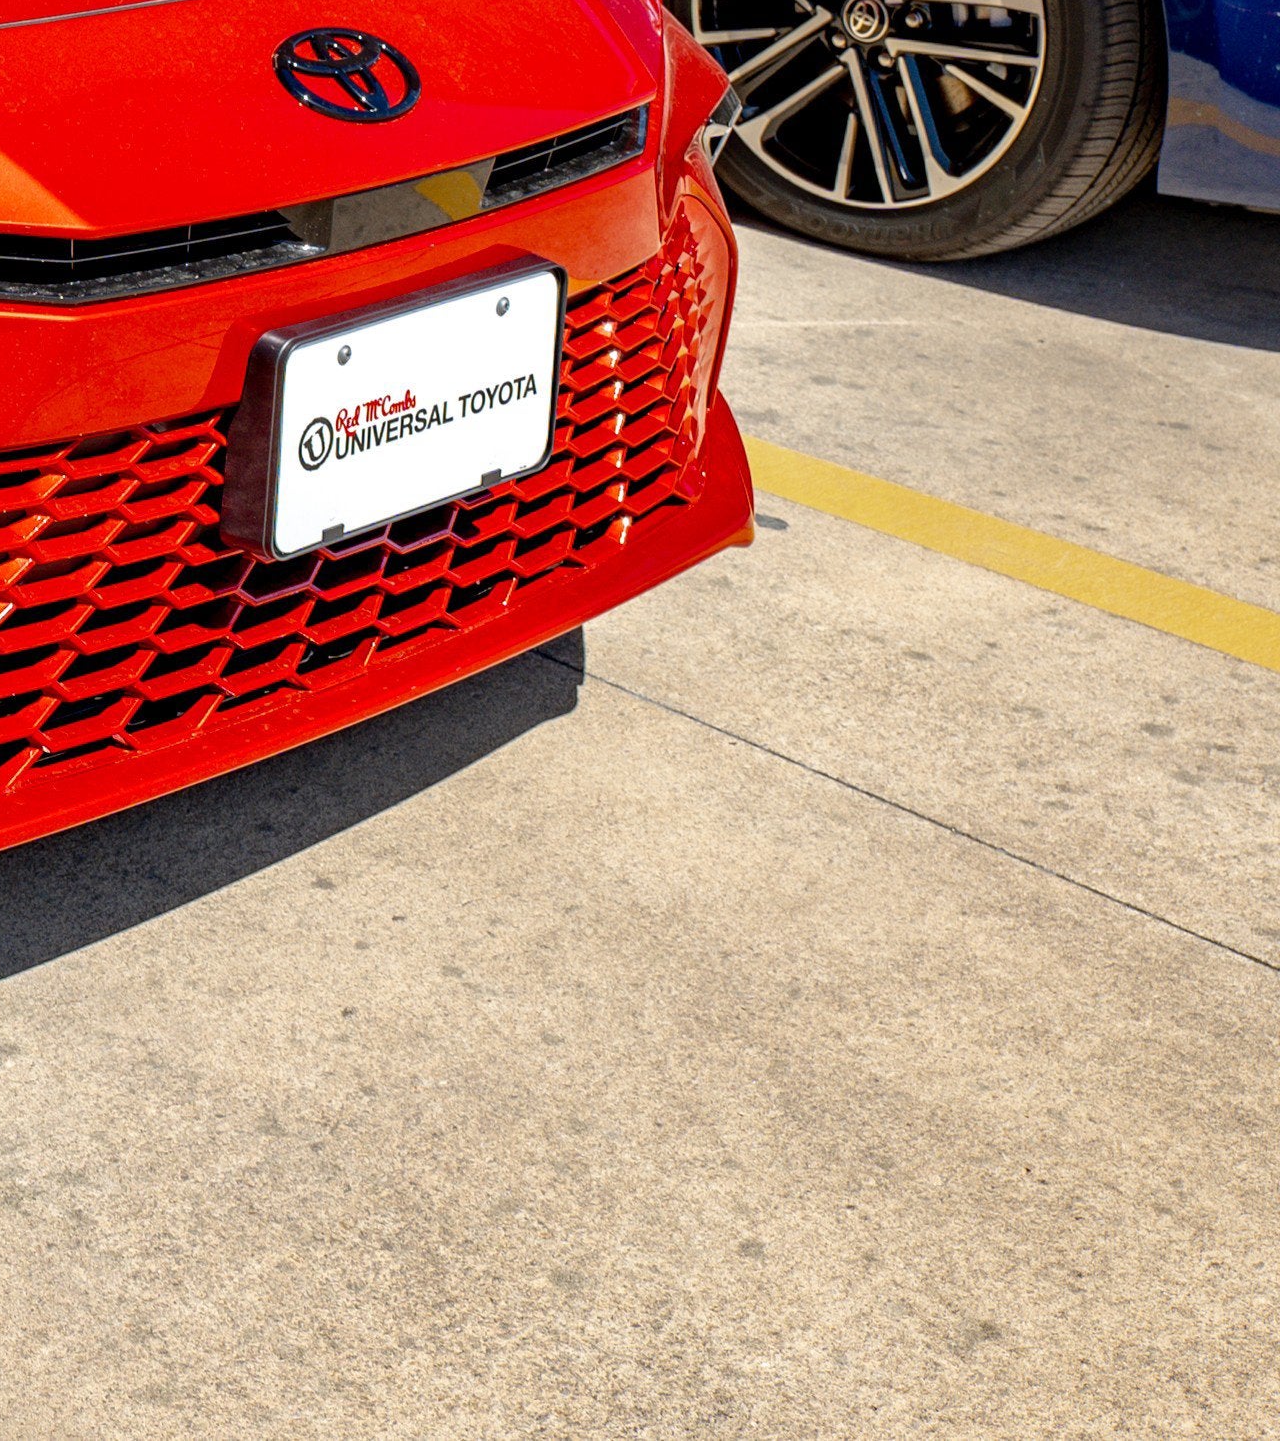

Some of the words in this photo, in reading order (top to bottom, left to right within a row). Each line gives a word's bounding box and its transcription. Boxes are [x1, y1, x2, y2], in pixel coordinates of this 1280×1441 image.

[335, 406, 360, 437] Red
[362, 389, 417, 423] McCombs
[335, 400, 454, 460] UNIVERSAL
[458, 373, 538, 418] TOYOTA
